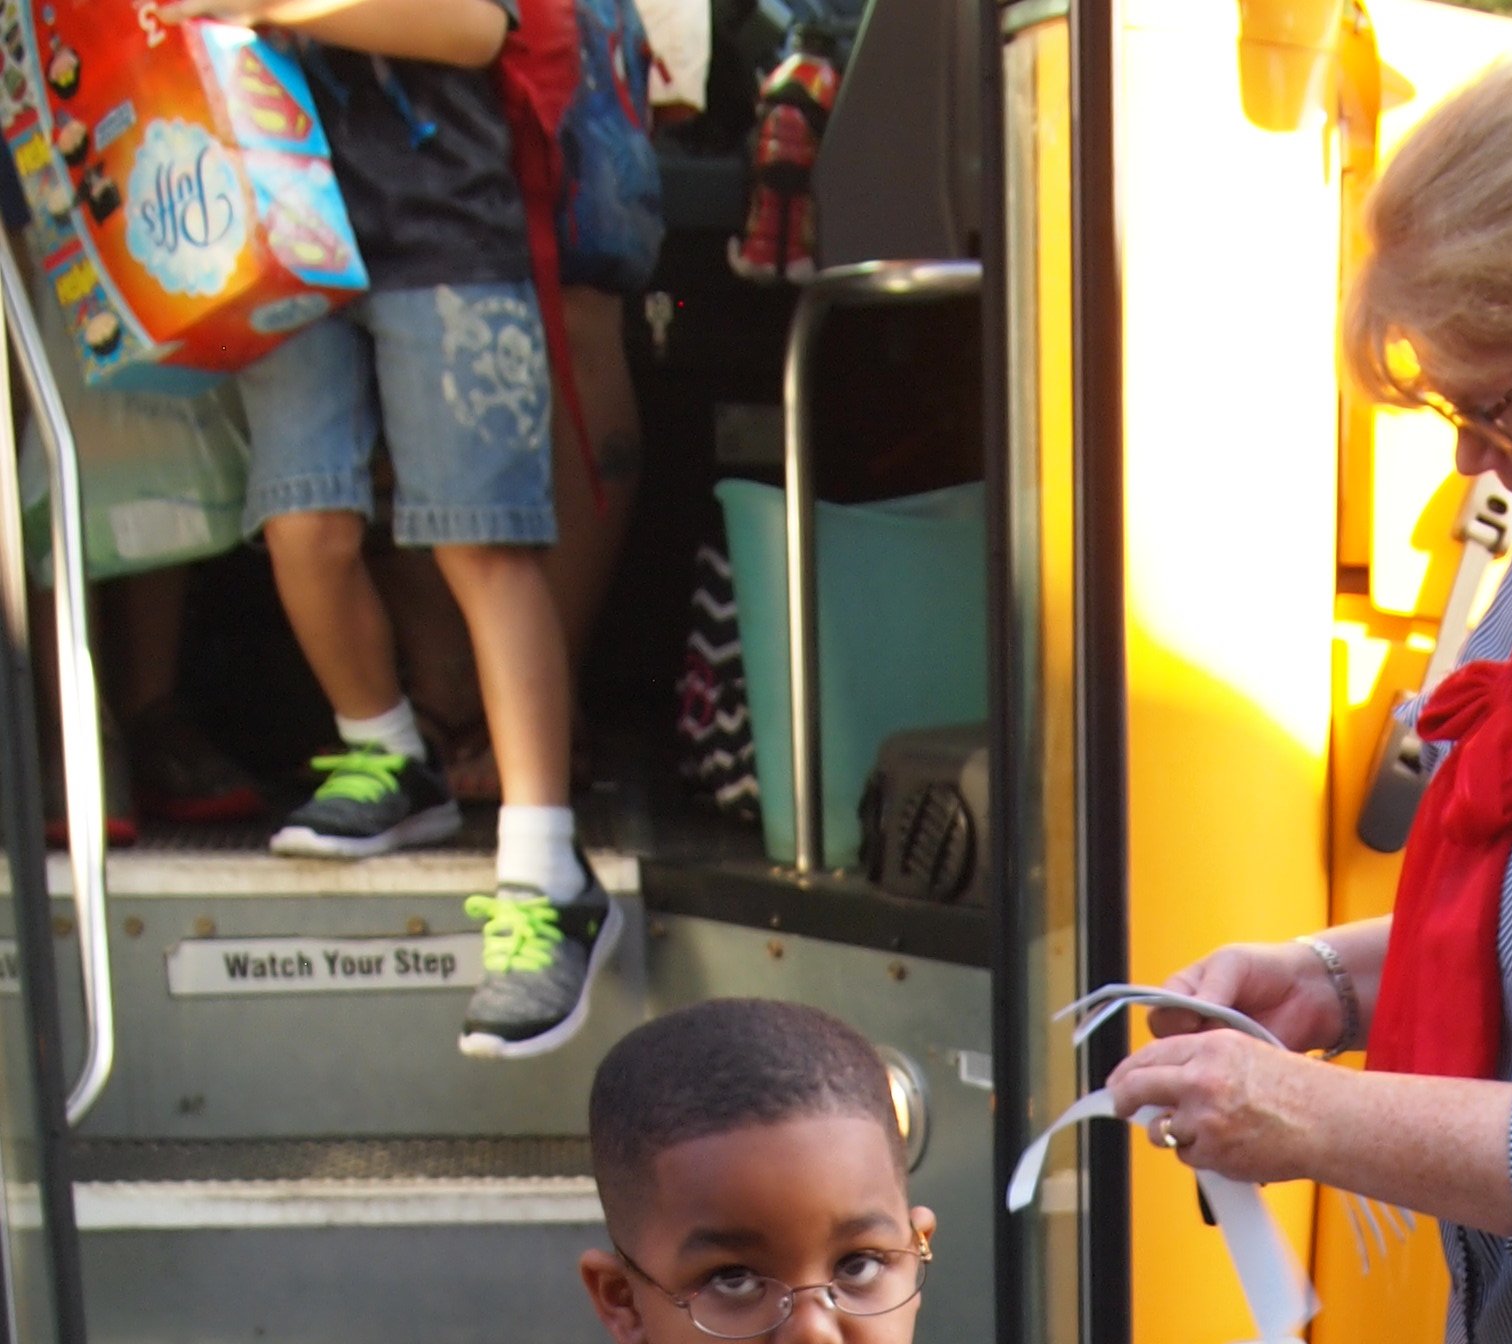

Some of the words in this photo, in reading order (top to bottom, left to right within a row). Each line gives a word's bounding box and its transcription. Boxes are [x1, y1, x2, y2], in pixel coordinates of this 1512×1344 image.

[140, 147, 234, 253] Puffs
[223, 950, 314, 979] Watch
[322, 949, 385, 977] Your
[394, 946, 457, 979] Step
